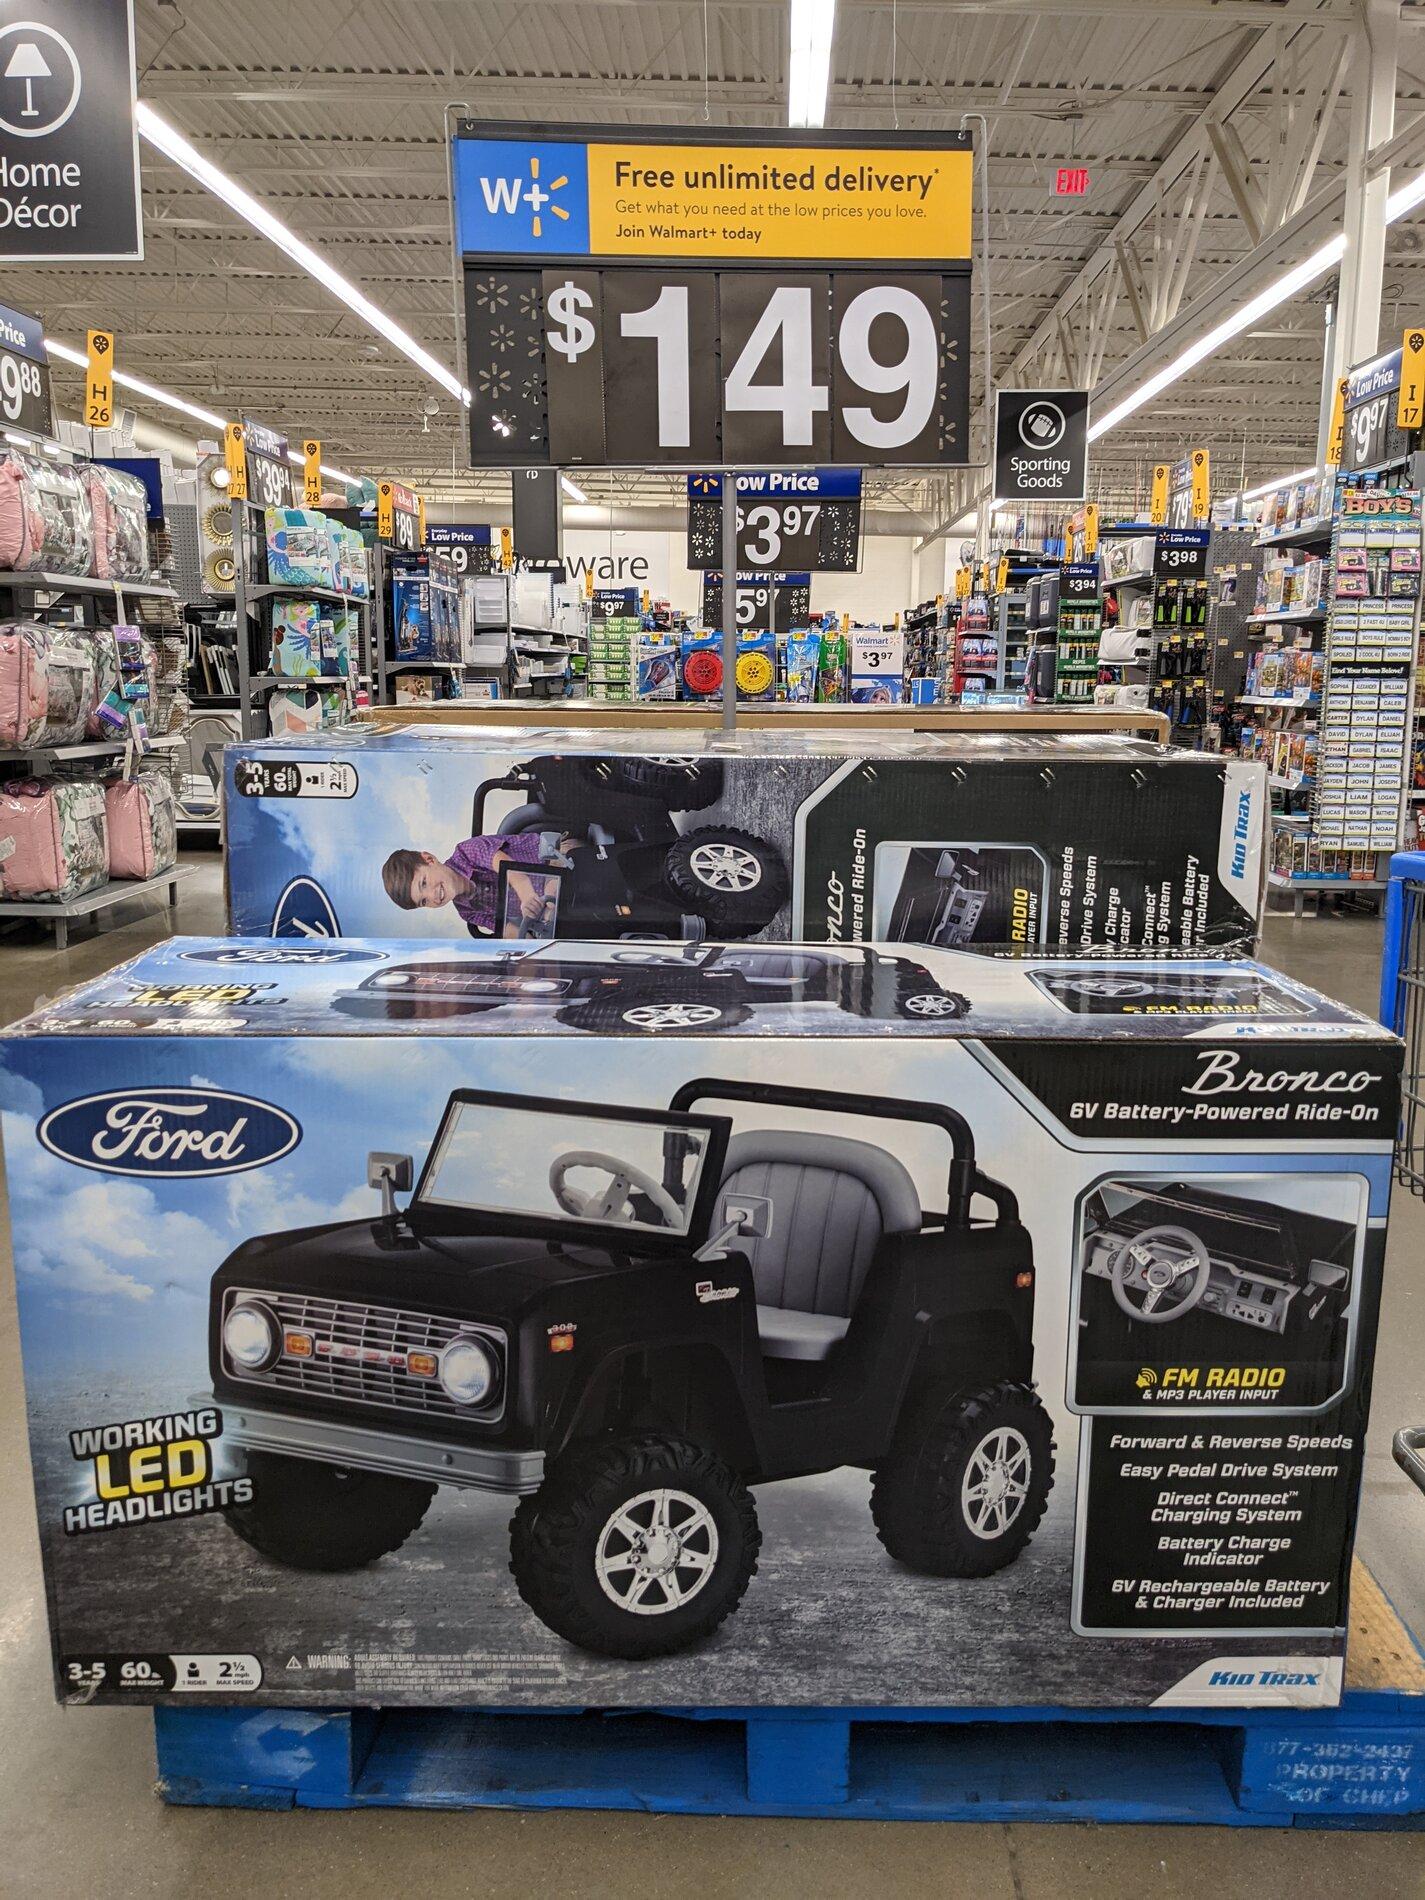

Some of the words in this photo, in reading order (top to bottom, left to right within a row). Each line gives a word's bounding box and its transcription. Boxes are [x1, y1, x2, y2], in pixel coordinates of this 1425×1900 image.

[615, 162, 674, 189] Free
[684, 164, 814, 192] unlimited
[1057, 169, 1087, 194] EXIT
[615, 199, 642, 215] Get
[645, 201, 680, 216] what
[684, 204, 708, 219] you
[713, 201, 746, 217] need
[751, 203, 764, 218] at
[766, 202, 790, 218] the
[795, 202, 818, 218] low
[823, 204, 864, 220] prices
[867, 207, 892, 221] you
[896, 204, 926, 219] love.
[615, 224, 644, 238] Join
[649, 226, 718, 240] Walmart+
[722, 226, 762, 243] today
[547, 281, 938, 449] $149
[1356, 378, 1372, 398] Low
[1373, 368, 1394, 392] Price
[92, 384, 106, 401] H
[90, 406, 110, 422] 26
[1403, 408, 1418, 423] 17
[236, 466, 244, 478] H
[1010, 456, 1071, 475] Sporting
[237, 484, 246, 494] 27
[308, 476, 317, 488] H
[736, 476, 766, 491] ow
[770, 473, 820, 491] Price
[1017, 473, 1063, 488] Goods
[306, 491, 320, 502] 28
[382, 513, 390, 522] H
[1151, 513, 1161, 522] 20
[1194, 504, 1204, 514] 19
[380, 526, 392, 535] 29
[431, 532, 450, 541] Low
[452, 532, 474, 542] Price
[1161, 550, 1198, 566] $398
[566, 556, 649, 580] ware
[1069, 580, 1096, 592] $394
[600, 601, 624, 616] $997
[856, 637, 888, 645] Walmart
[862, 652, 893, 668] $397
[246, 762, 264, 795] 3-5
[274, 772, 287, 792] 60
[852, 828, 866, 890] Ride-On
[1060, 846, 1074, 897] Speeds
[1182, 854, 1200, 906] Battery
[1083, 856, 1098, 906] System
[1028, 892, 1038, 915] INPUT
[1104, 887, 1121, 937] Charge
[1157, 882, 1171, 932] System
[1196, 874, 1210, 934] Included
[1012, 888, 1029, 942] RADIO
[1081, 909, 1093, 946] Drive
[218, 950, 350, 964] Ford
[134, 990, 253, 1001] LED
[1181, 1050, 1383, 1095] Bronco
[1070, 1102, 1098, 1119] 6V
[1104, 1102, 1288, 1123] Battery-Powered
[1295, 1104, 1379, 1121] Ride-On
[92, 1100, 248, 1160] Ford
[1162, 1368, 1200, 1387] FM
[1206, 1368, 1286, 1387] RADIO
[1142, 1390, 1152, 1400] &
[1156, 1390, 1185, 1400] MP3
[1187, 1390, 1236, 1400] PLAYER
[1239, 1390, 1280, 1400] INPUT
[71, 1410, 218, 1456] WORKING
[1110, 1434, 1188, 1449] Forward
[1191, 1435, 1204, 1449] &
[1209, 1435, 1282, 1449] Reverse
[1287, 1435, 1353, 1451] Speeds
[96, 1439, 206, 1499] LED
[1120, 1464, 1163, 1480] Easy
[1167, 1464, 1216, 1478] Pedal
[1221, 1464, 1266, 1478] Drive
[1272, 1464, 1338, 1480] System
[64, 1478, 254, 1532] HEADLIGHTS
[1157, 1492, 1212, 1505] Direct
[1151, 1508, 1231, 1524] Charging
[1236, 1508, 1302, 1524] System
[1158, 1536, 1224, 1551] Battery
[1228, 1536, 1292, 1551] Charge
[1183, 1553, 1264, 1566] Indicator
[1111, 1580, 1136, 1592] 6V
[1139, 1579, 1260, 1594] Rechargeable
[1264, 1579, 1331, 1594] Battery
[1135, 1596, 1148, 1609] &
[1152, 1595, 1224, 1611] Charger
[1228, 1595, 1305, 1608] Included
[68, 1662, 106, 1680] 3-5
[120, 1662, 151, 1678] 60
[1276, 1763, 1411, 1782] PROPERTY
